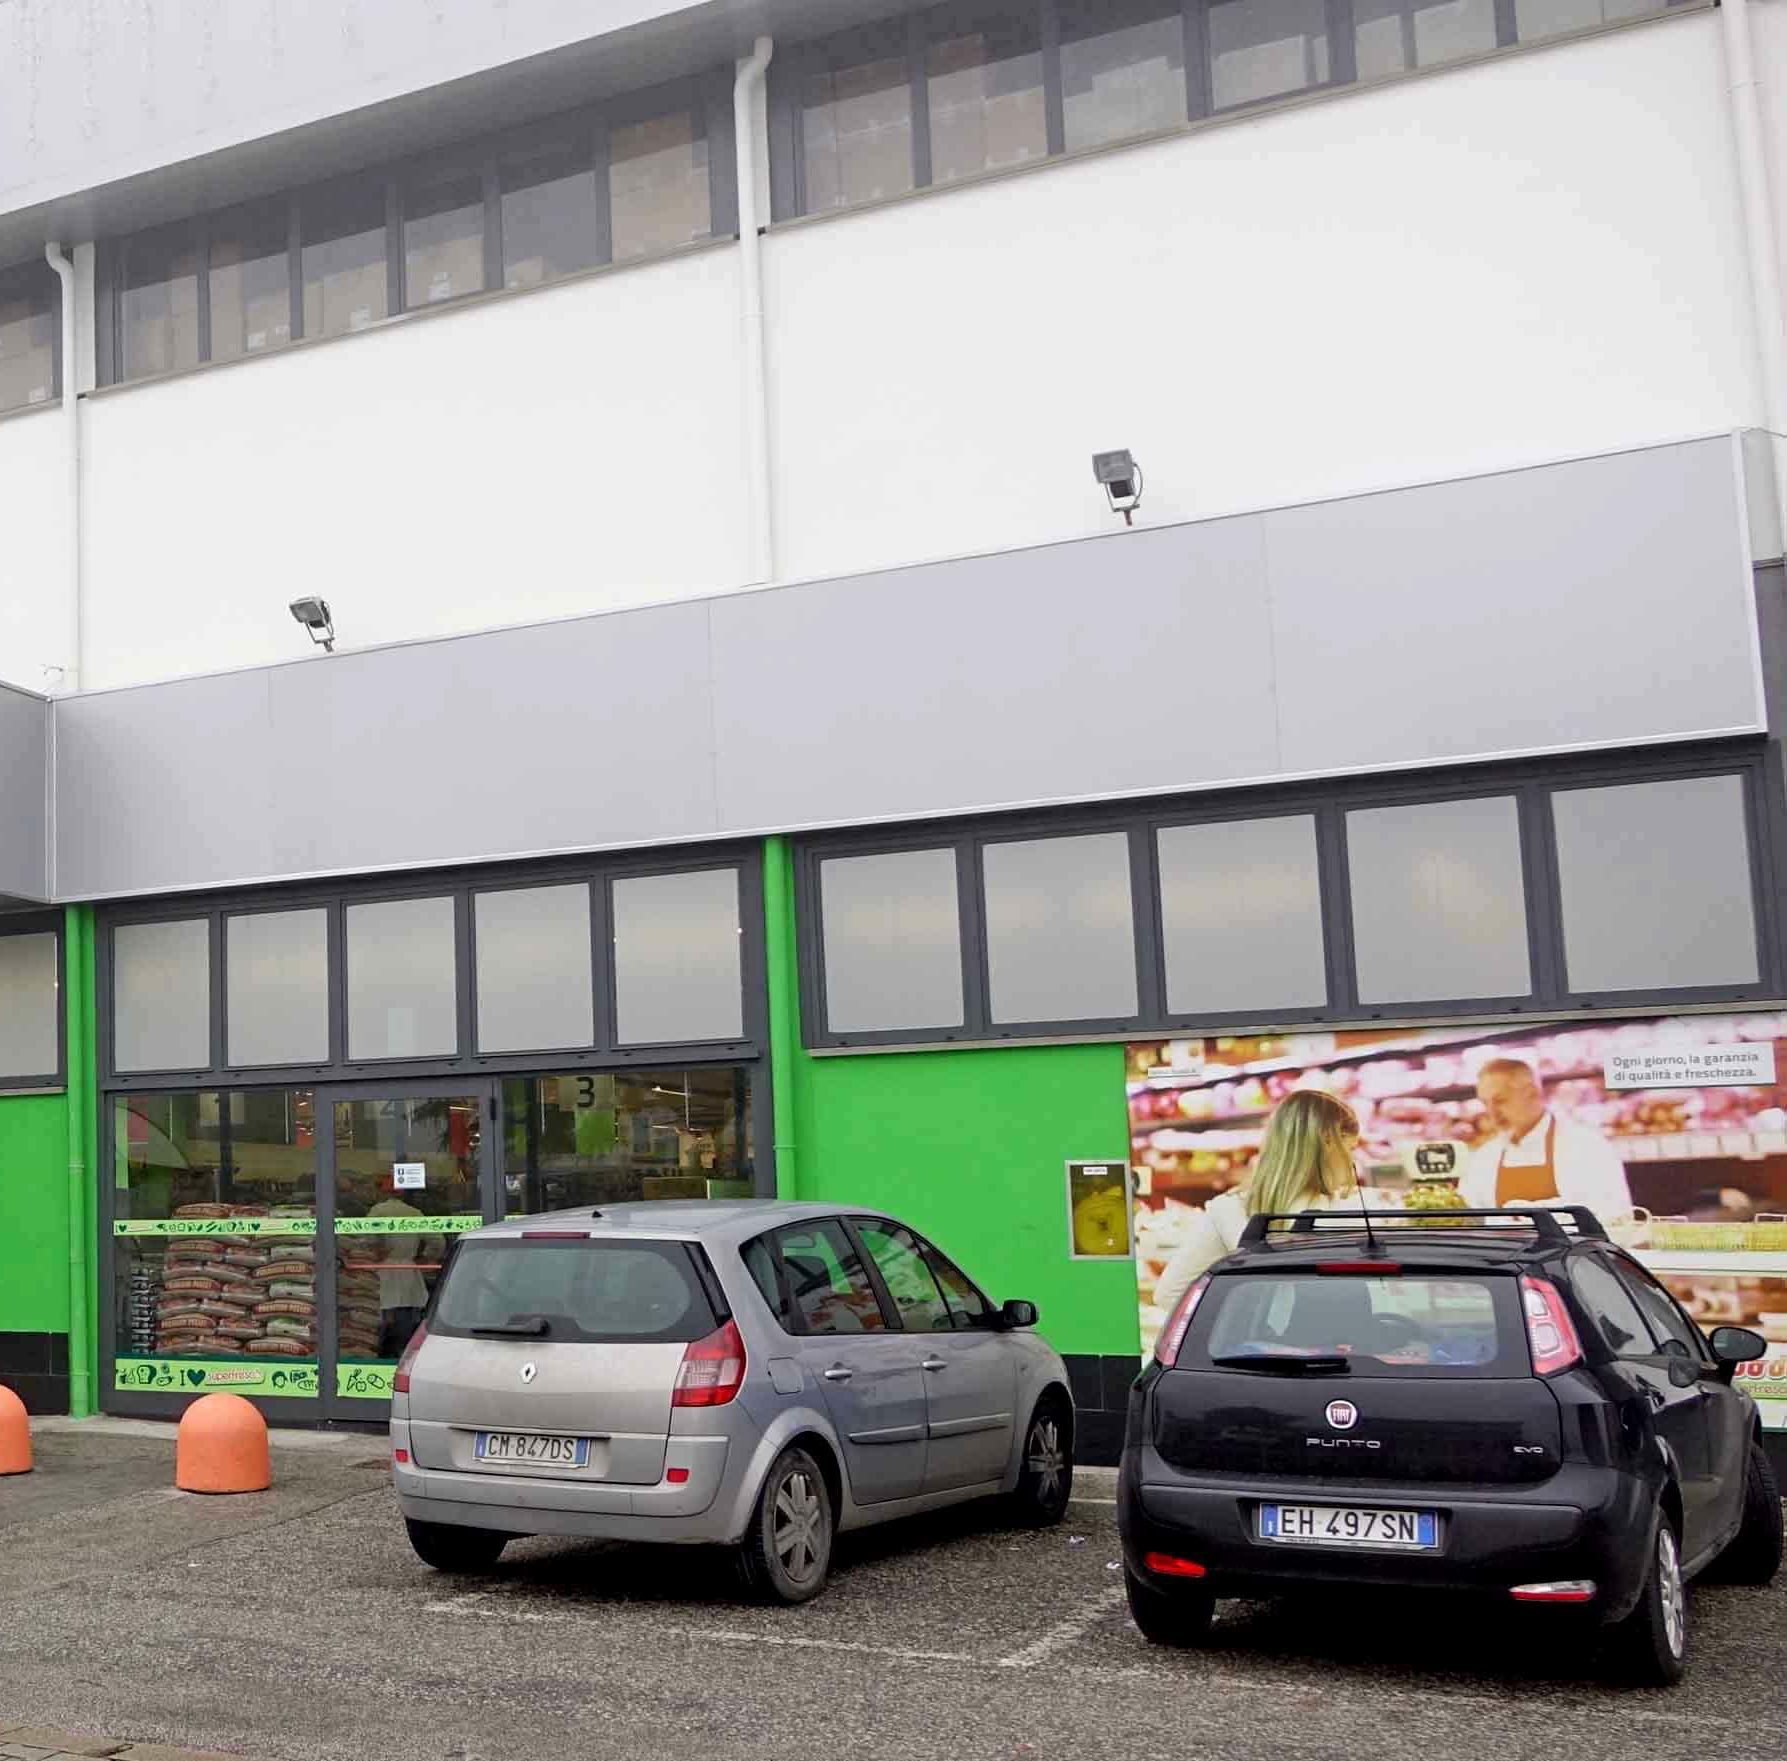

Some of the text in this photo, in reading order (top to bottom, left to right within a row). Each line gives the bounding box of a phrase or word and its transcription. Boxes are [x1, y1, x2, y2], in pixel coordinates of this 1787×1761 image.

[1612, 1052, 1759, 1069] Ogni giorno, la garanzia
[1614, 1067, 1757, 1082] di qualità e freschezza.
[576, 1076, 596, 1108] 3
[1331, 1408, 1350, 1421] FIAT
[488, 1435, 510, 1457] CM
[515, 1436, 575, 1460] 847DS
[1306, 1437, 1381, 1449] PUNTO
[1513, 1445, 1543, 1455] EVO
[1281, 1509, 1314, 1535] EH
[1325, 1510, 1415, 1541] 497SN
